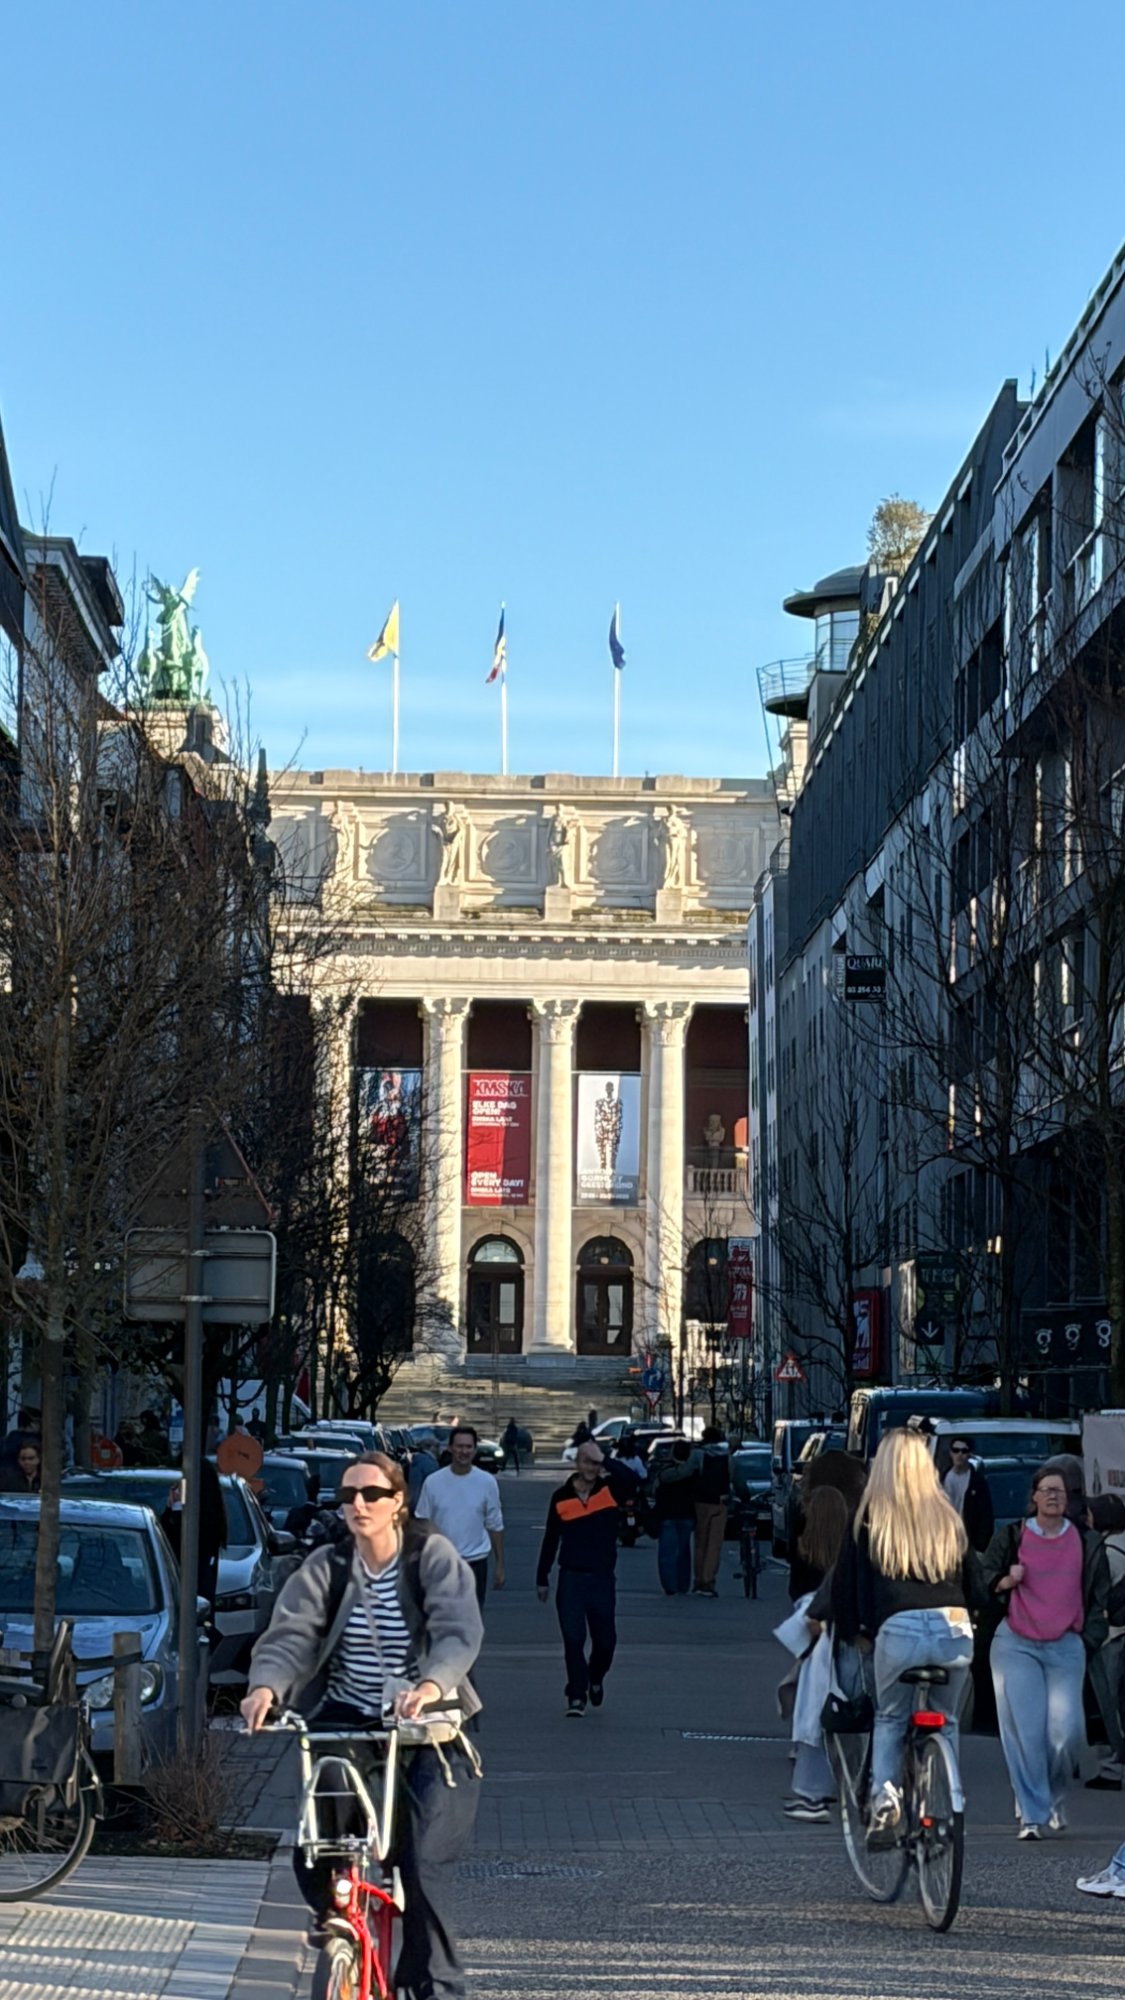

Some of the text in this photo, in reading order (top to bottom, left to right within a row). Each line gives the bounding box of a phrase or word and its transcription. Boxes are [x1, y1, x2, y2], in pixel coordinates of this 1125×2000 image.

[472, 1101, 517, 1109] ELKE DAG
[471, 1171, 497, 1179] OPEN
[471, 1178, 524, 1187] EVERY DAY!
